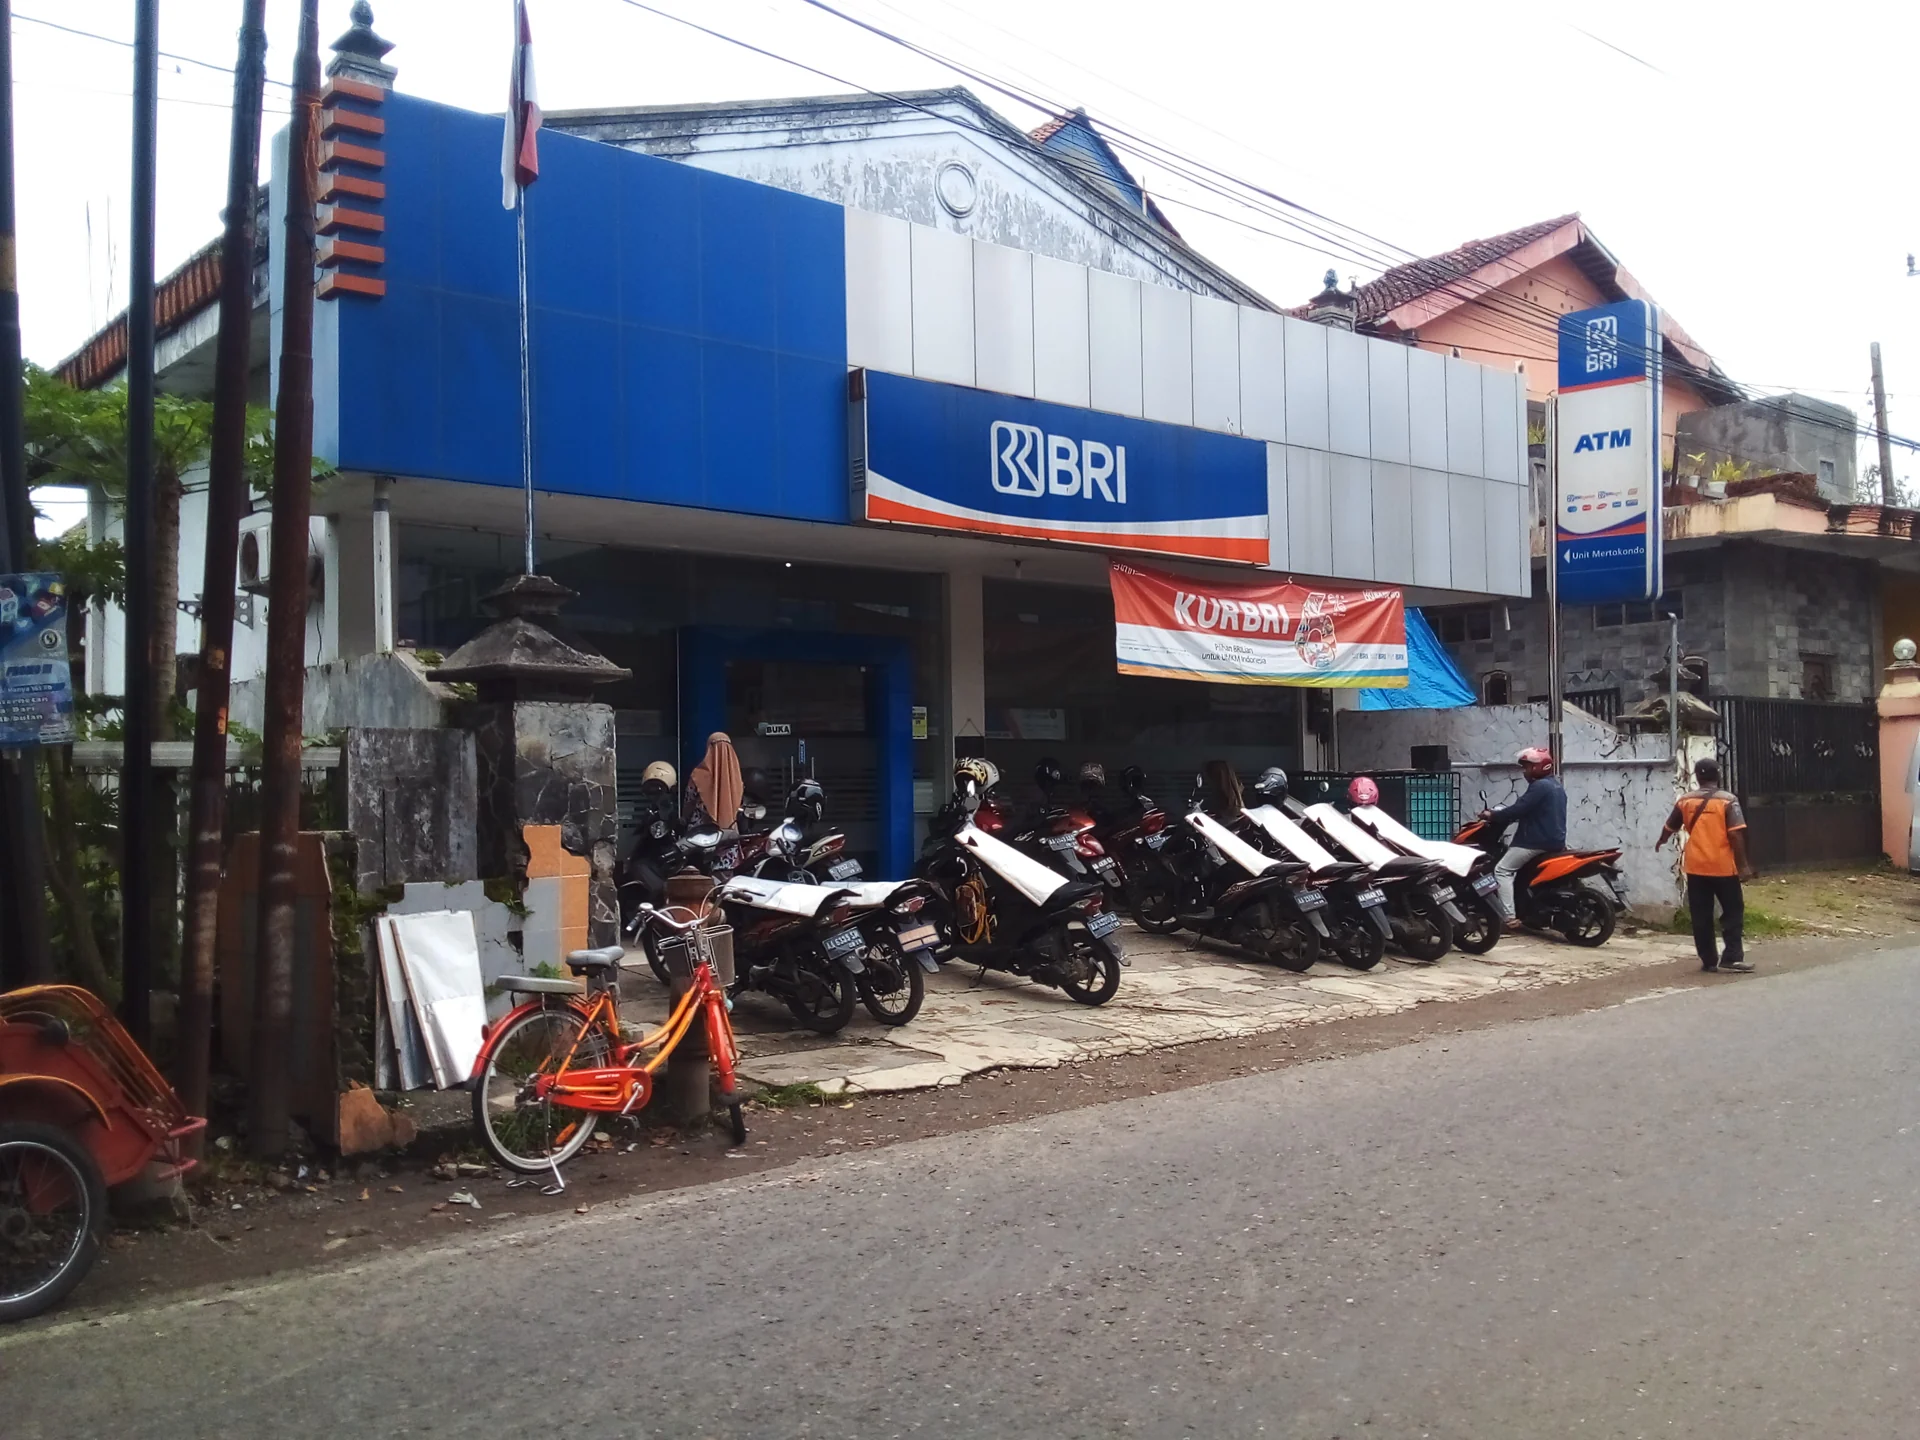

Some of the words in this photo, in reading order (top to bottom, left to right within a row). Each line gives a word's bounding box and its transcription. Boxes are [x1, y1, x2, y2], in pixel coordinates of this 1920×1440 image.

[1586, 351, 1617, 373] BRI
[1573, 428, 1631, 453] ATM
[1048, 434, 1126, 504] BRI
[1572, 552, 1590, 560] Unit
[1174, 591, 1290, 634] KURBRI
[1201, 653, 1221, 661] untuk
[12, 706, 36, 714] Dari
[766, 725, 790, 734] BUKA
